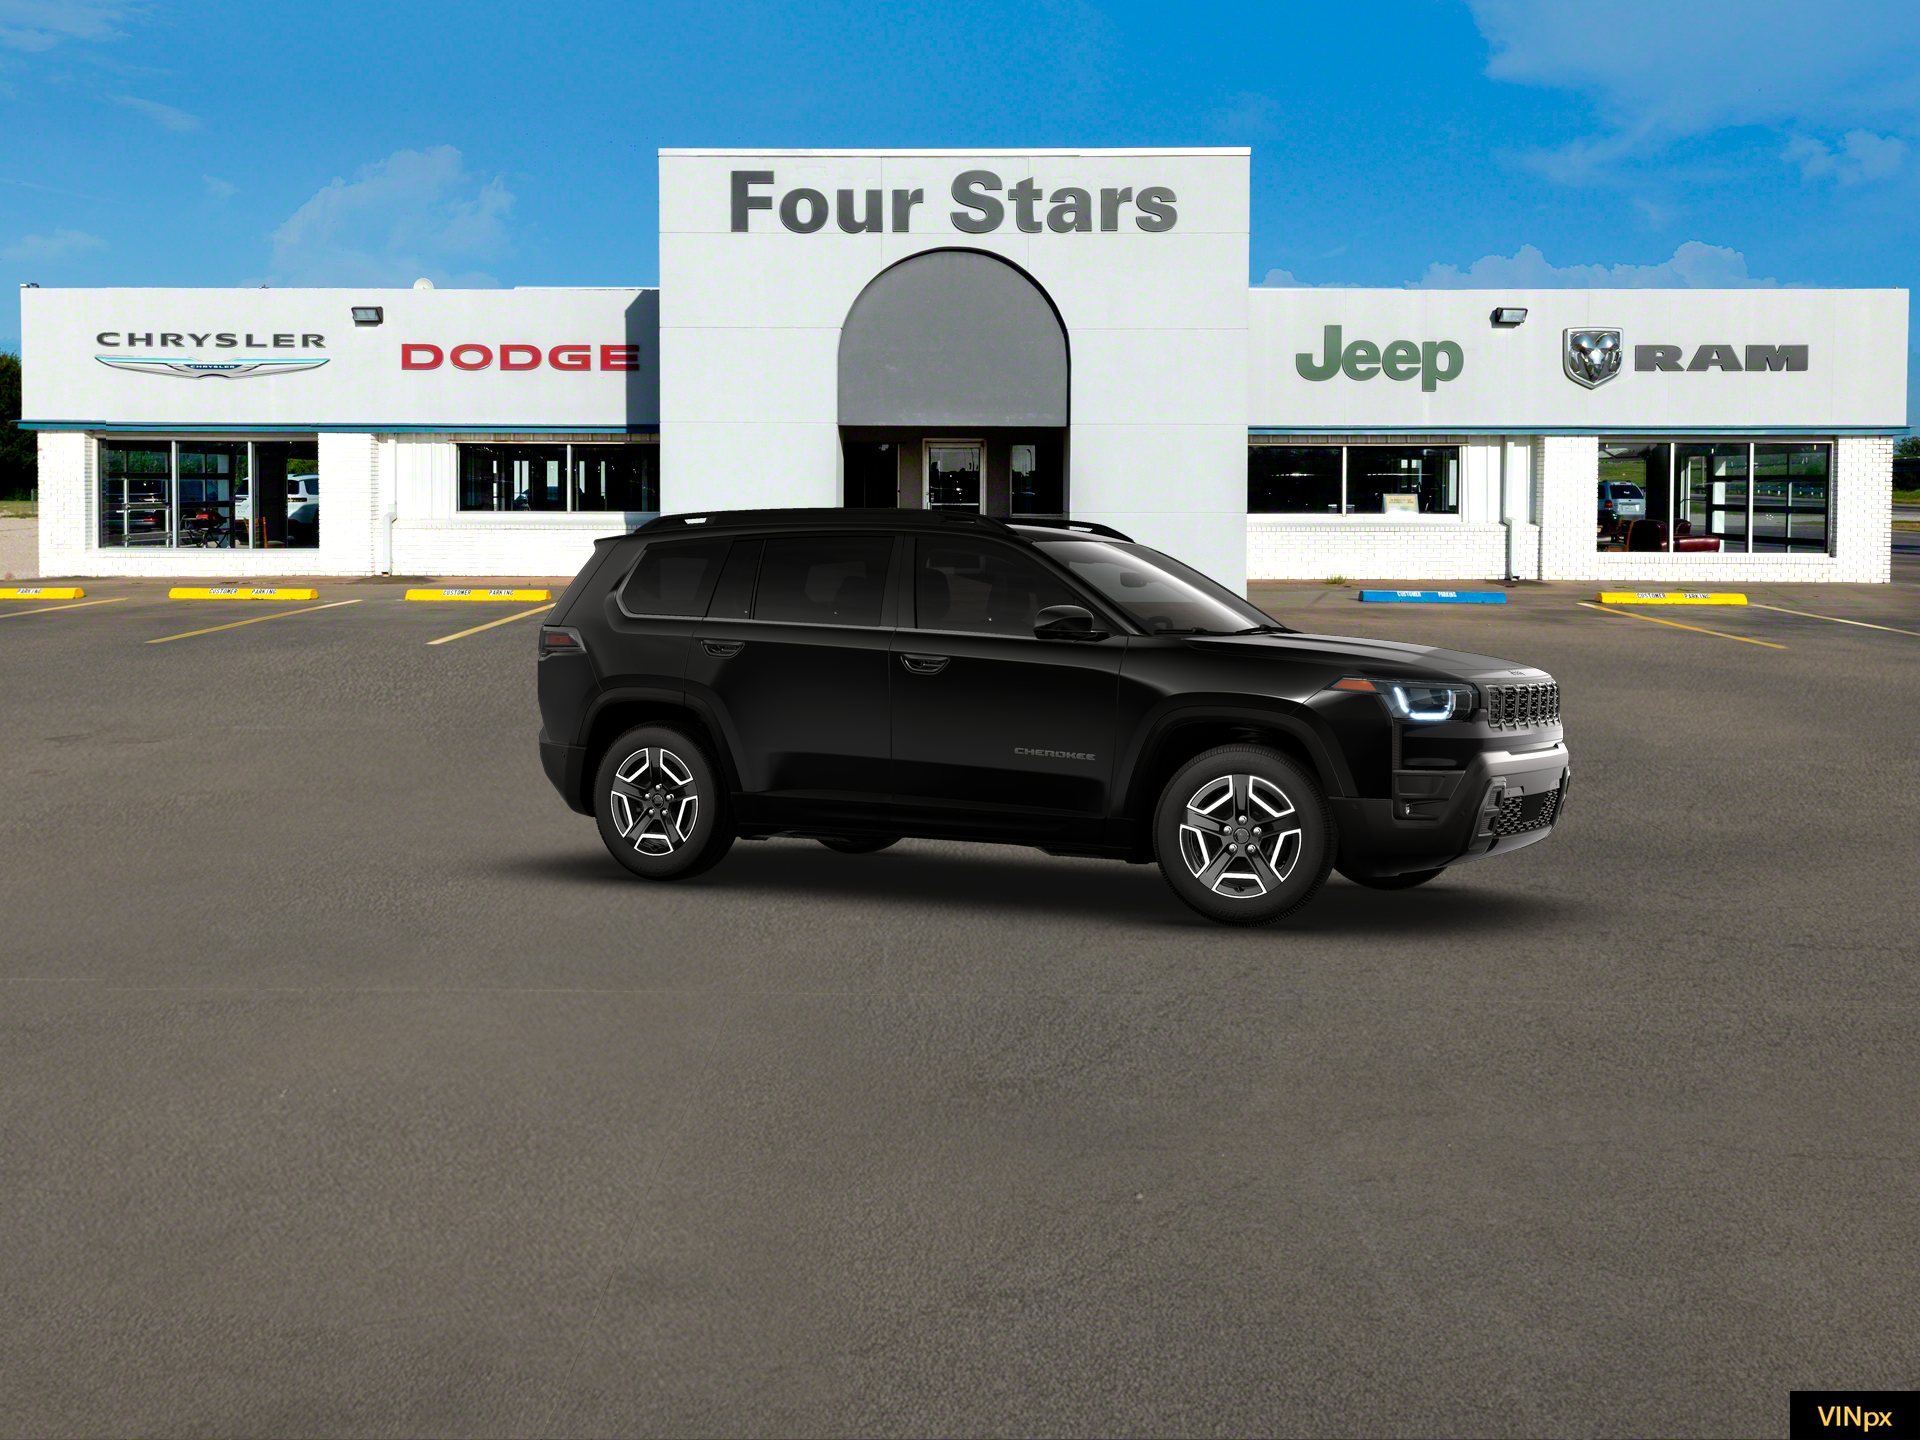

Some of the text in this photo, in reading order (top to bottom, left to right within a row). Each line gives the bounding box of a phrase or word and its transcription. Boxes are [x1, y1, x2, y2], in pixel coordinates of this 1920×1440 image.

[730, 169, 1178, 234] Four Stars
[96, 331, 326, 349] CHRYSLER
[401, 343, 640, 371] DODGE
[1295, 325, 1464, 393] Jeep
[1634, 344, 1809, 372] RAM
[16, 587, 43, 595] PARKING
[208, 587, 239, 595] CUSTOMER
[1014, 747, 1096, 761] CHEROKEE
